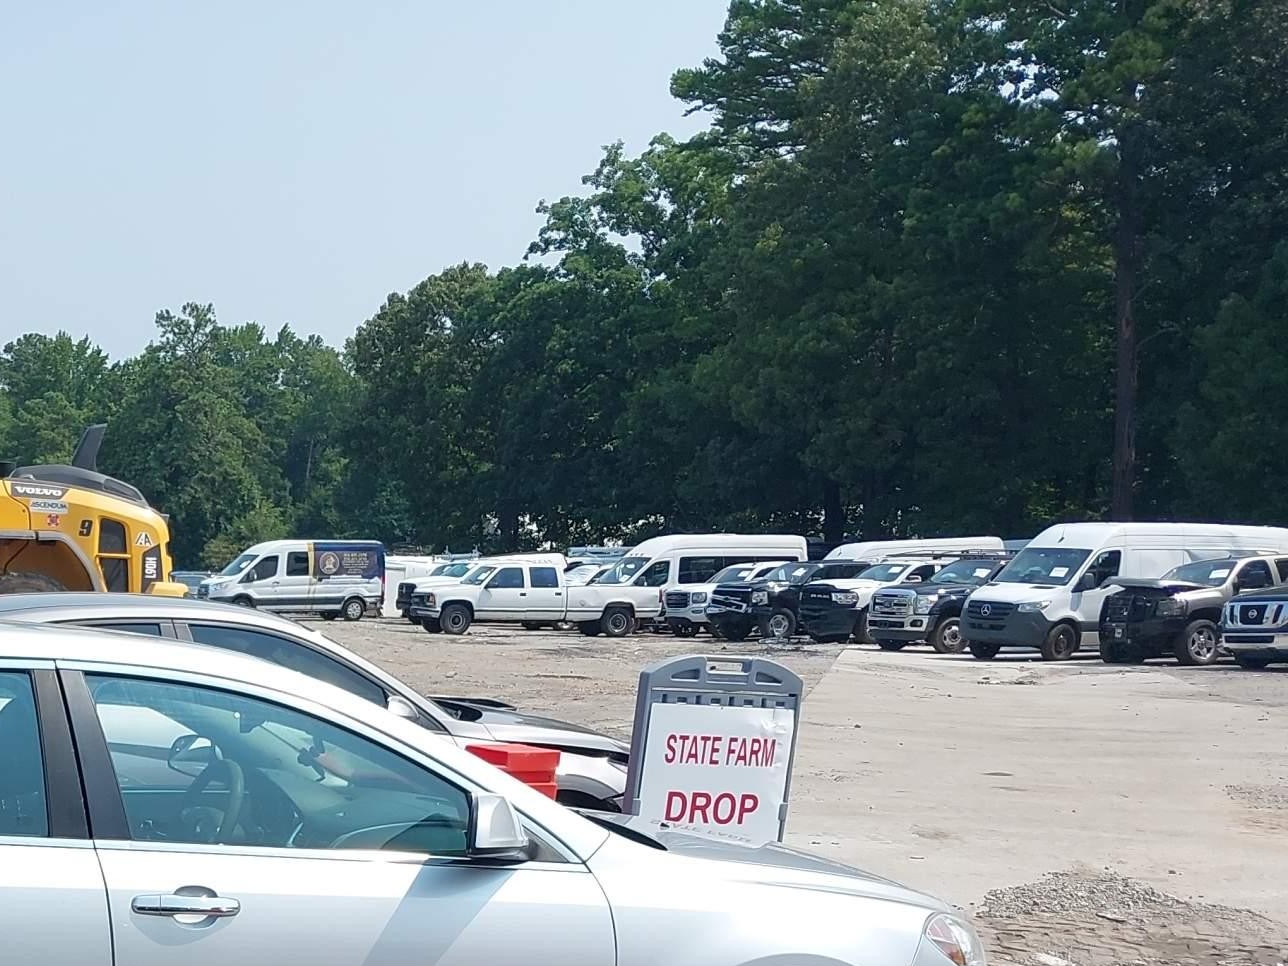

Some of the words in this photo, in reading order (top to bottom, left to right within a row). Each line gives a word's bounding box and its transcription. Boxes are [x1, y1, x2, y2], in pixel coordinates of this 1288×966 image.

[15, 486, 63, 497] VOLVO
[78, 519, 93, 537] 9
[144, 556, 158, 579] L90H
[664, 734, 723, 766] STATE
[725, 736, 777, 768] FARM
[664, 790, 760, 825] DROP
